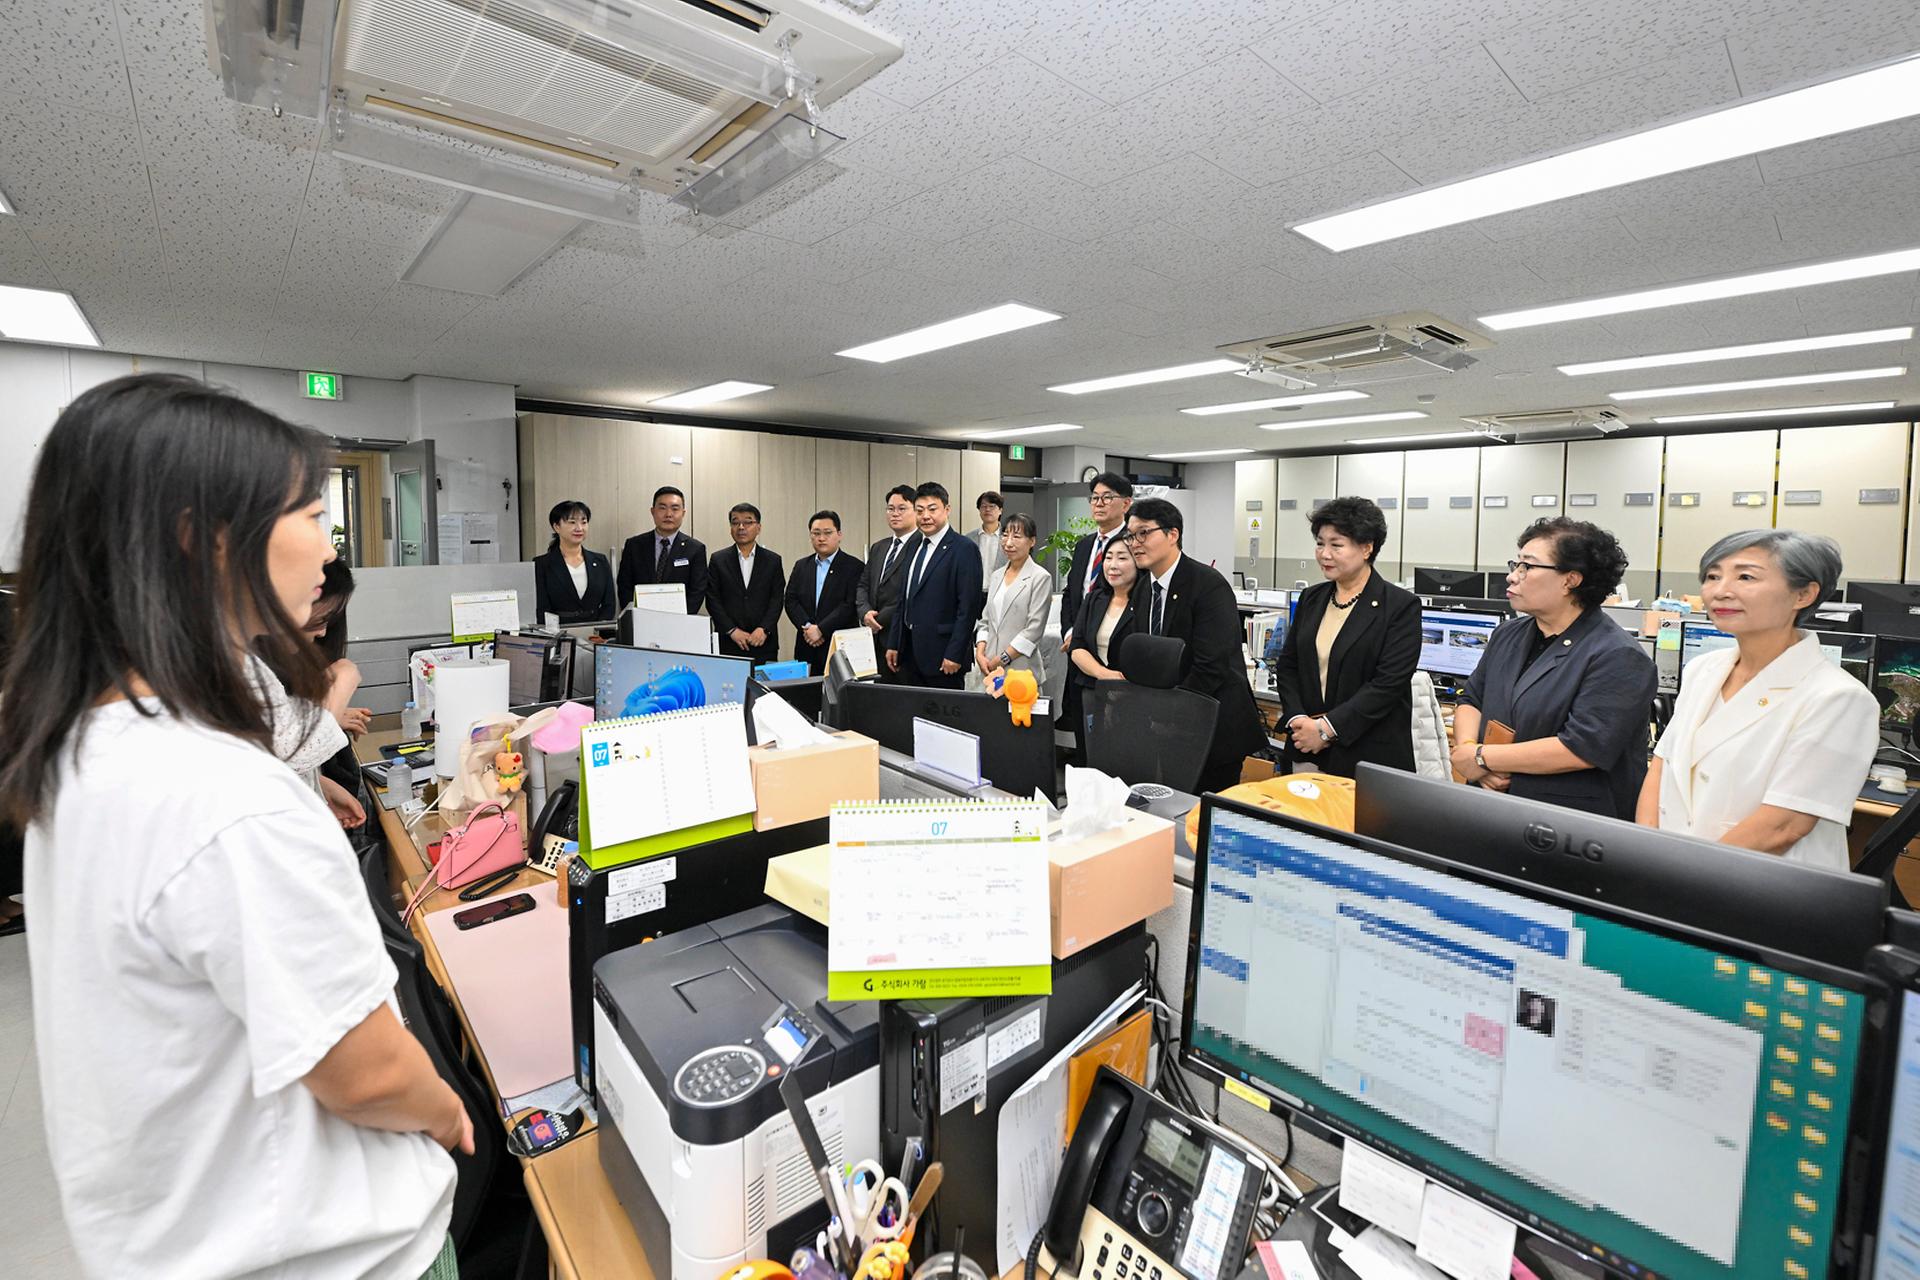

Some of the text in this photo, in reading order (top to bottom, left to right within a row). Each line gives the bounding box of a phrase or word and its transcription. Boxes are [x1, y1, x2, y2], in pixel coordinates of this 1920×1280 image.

[594, 749, 607, 761] 07
[931, 822, 948, 836] 07
[1563, 833, 1604, 863] LG
[881, 980, 910, 990] 주식회사
